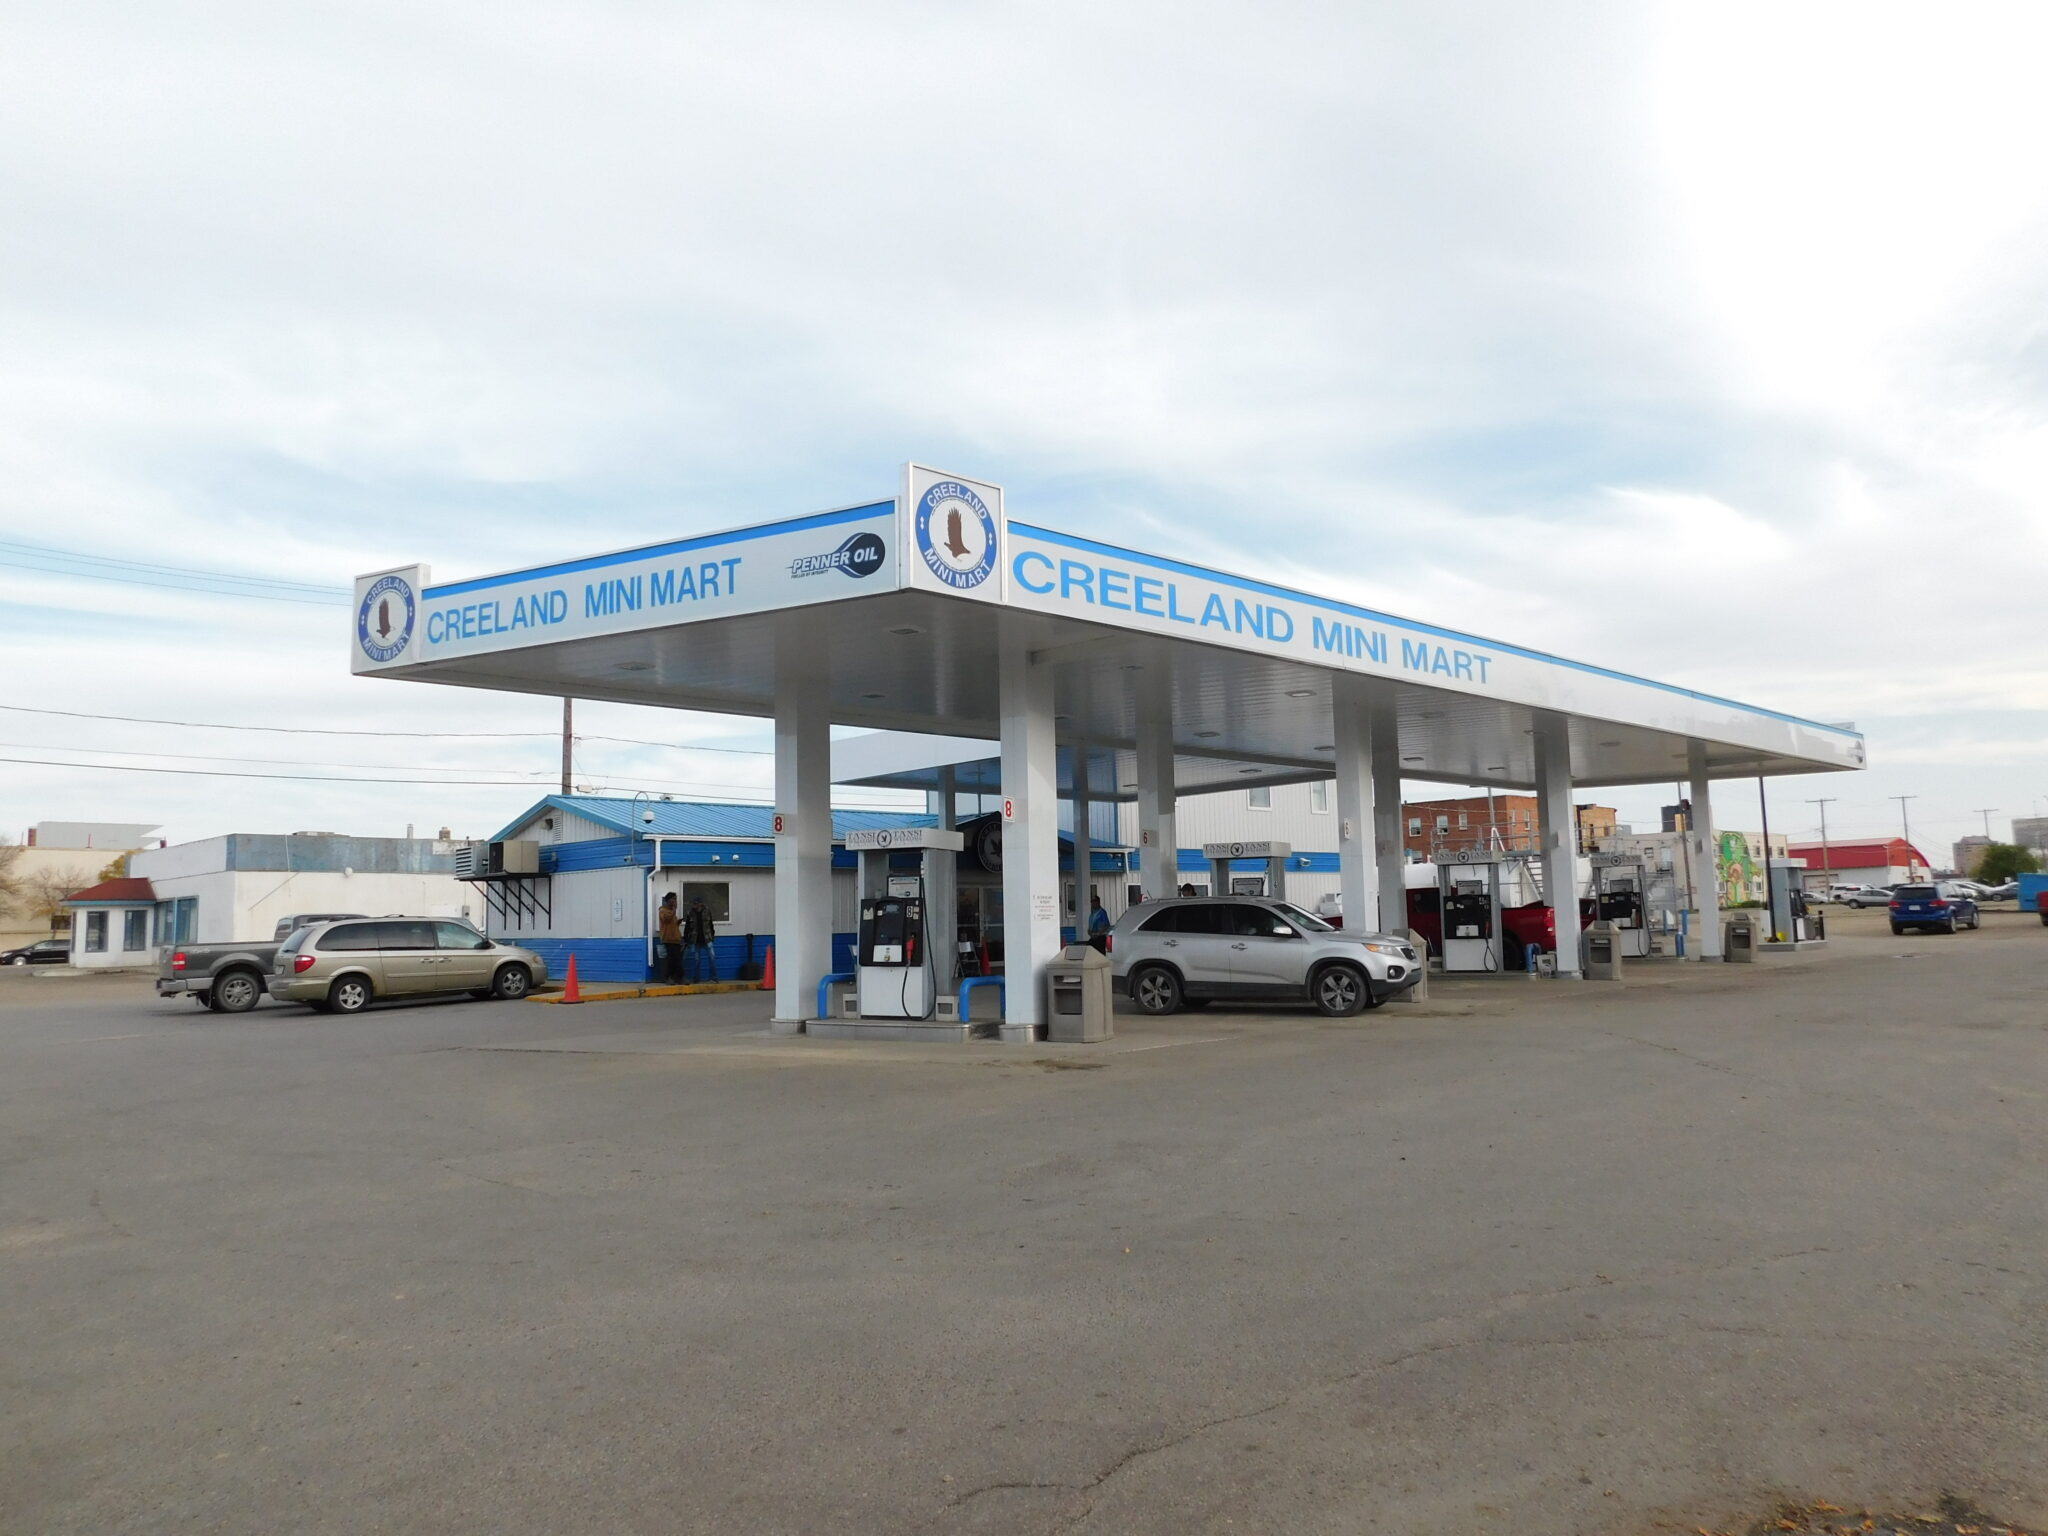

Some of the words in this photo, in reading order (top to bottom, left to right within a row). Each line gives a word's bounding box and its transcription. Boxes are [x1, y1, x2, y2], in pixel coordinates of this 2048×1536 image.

[927, 483, 987, 519] CREELAND
[792, 551, 850, 574] PENNER
[853, 547, 878, 562] OIL
[924, 548, 952, 583] MINI
[956, 559, 991, 587] MART
[367, 577, 410, 604] CREELAND
[427, 588, 568, 645] CREELAND
[585, 575, 643, 619] MINI
[650, 557, 742, 608] MART
[1012, 551, 1295, 643] CREELAND
[1313, 616, 1388, 664] MINI
[1401, 638, 1492, 684] MART
[362, 638, 382, 660] MINI
[383, 633, 409, 661] MART
[1005, 800, 1012, 817] 8
[775, 816, 782, 832] 8
[893, 830, 922, 840] TANSI
[1143, 831, 1148, 844] 6
